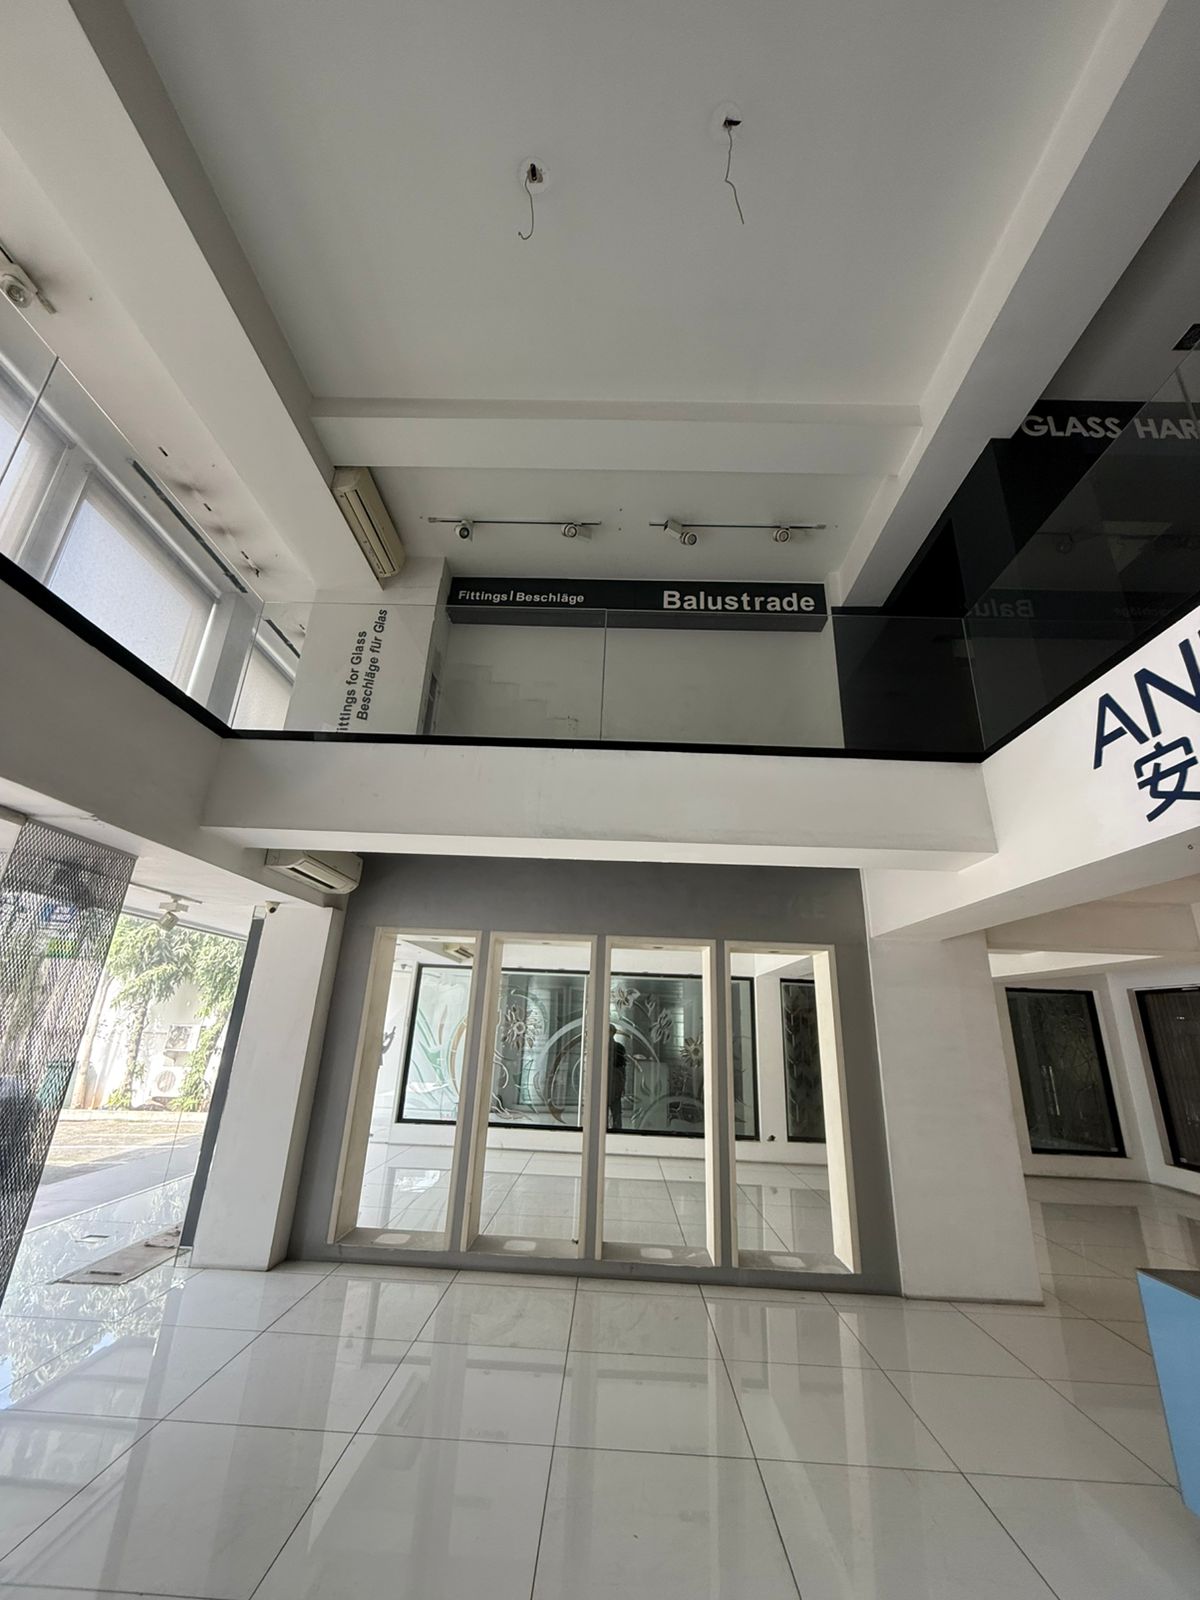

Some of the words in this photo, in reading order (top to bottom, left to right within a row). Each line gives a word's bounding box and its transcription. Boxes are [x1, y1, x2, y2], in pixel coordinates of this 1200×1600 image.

[1020, 415, 1123, 439] GLASS
[458, 590, 508, 603] Fittings
[516, 592, 585, 605] Beschläge
[662, 589, 816, 612] Balustrade
[350, 630, 367, 665] Glass
[356, 656, 380, 720] Beschläge
[373, 609, 388, 633] Glas
[345, 667, 359, 685] for
[336, 688, 358, 733] ittings
[1093, 629, 1200, 769] AN
[1134, 736, 1200, 822] 安
